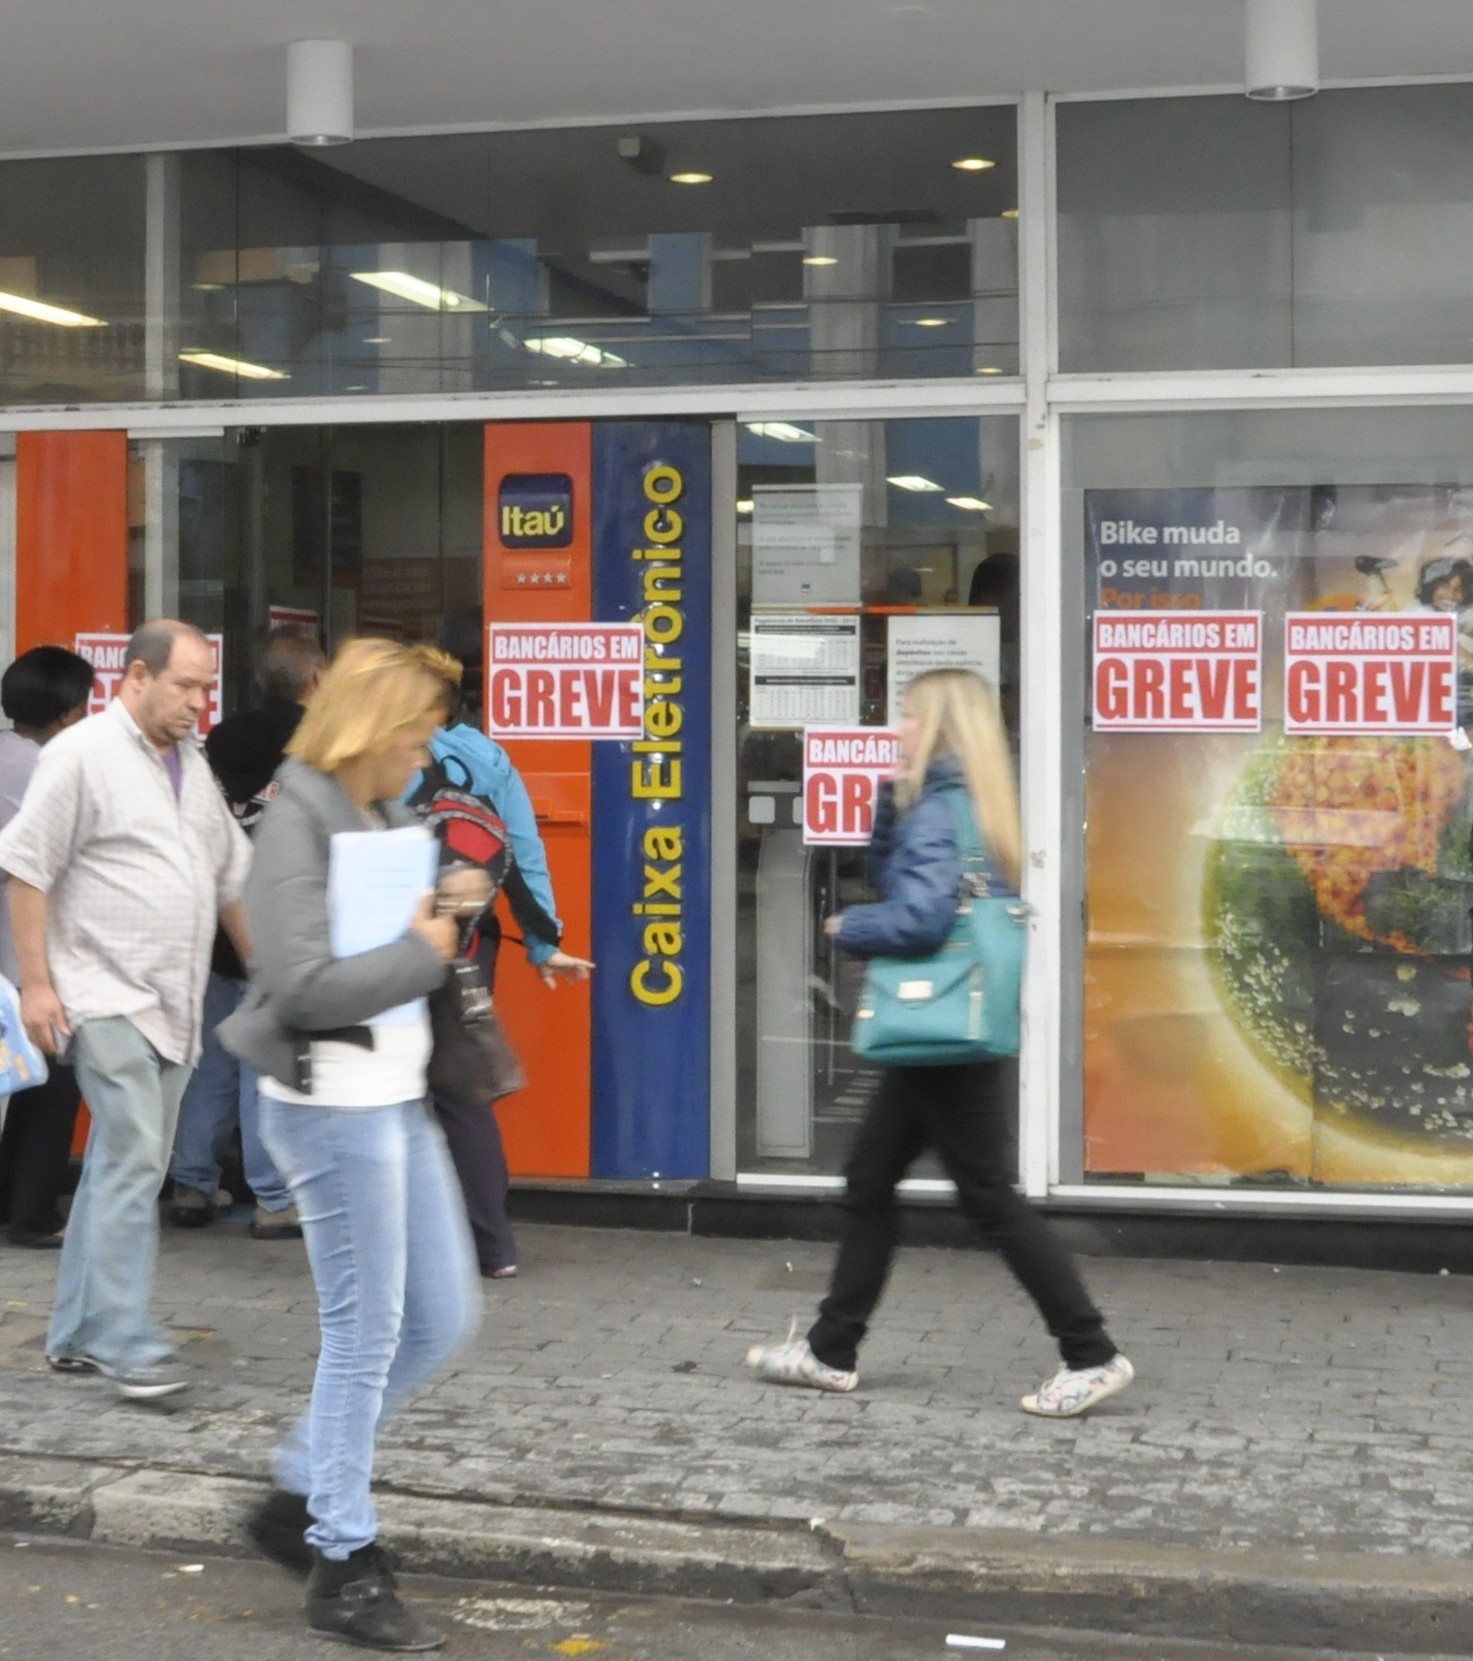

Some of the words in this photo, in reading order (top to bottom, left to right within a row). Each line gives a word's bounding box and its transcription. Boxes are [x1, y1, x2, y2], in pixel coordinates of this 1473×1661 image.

[502, 505, 565, 536] Itaú
[1101, 520, 1157, 545] Bike
[1163, 520, 1241, 545] muda
[1101, 561, 1118, 578] o
[1123, 561, 1168, 578] seu
[1174, 553, 1278, 579] mundo.
[494, 632, 606, 659] BANCÁRIOS
[610, 635, 639, 659] EM
[631, 465, 683, 798] Eletrônico
[1098, 620, 1220, 649] BANCÁRIOS
[1225, 624, 1256, 648] EM
[1291, 622, 1414, 652] BANCÁRIOS
[1420, 626, 1451, 651] EM
[492, 668, 642, 728] GREVE
[1096, 657, 1258, 720] GREVE
[1287, 660, 1453, 723] GREVE
[809, 735, 899, 764] BANCÁRI
[630, 825, 683, 1006] Caixa
